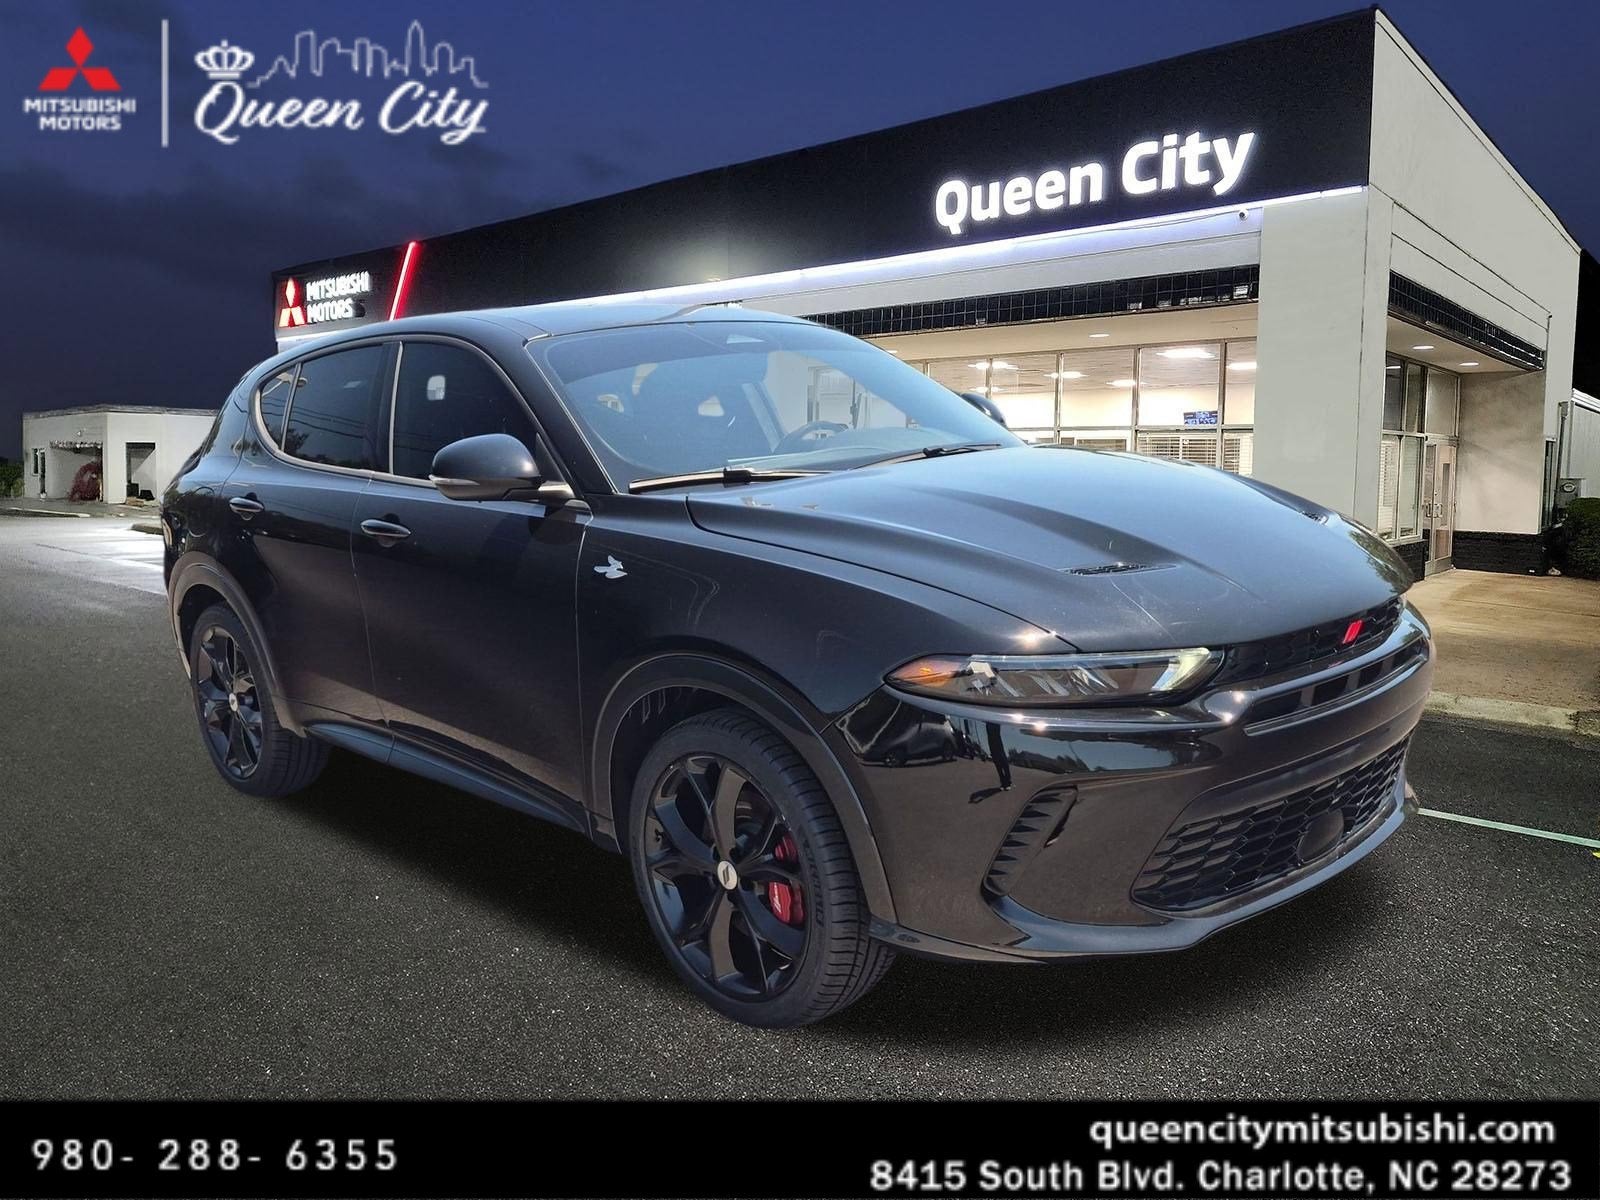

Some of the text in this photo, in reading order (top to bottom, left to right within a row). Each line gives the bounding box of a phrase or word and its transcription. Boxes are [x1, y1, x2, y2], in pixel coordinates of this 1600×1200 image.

[935, 131, 1255, 235] Queen City
[306, 270, 370, 301] MITSUBISHI
[306, 297, 354, 323] MOTORS
